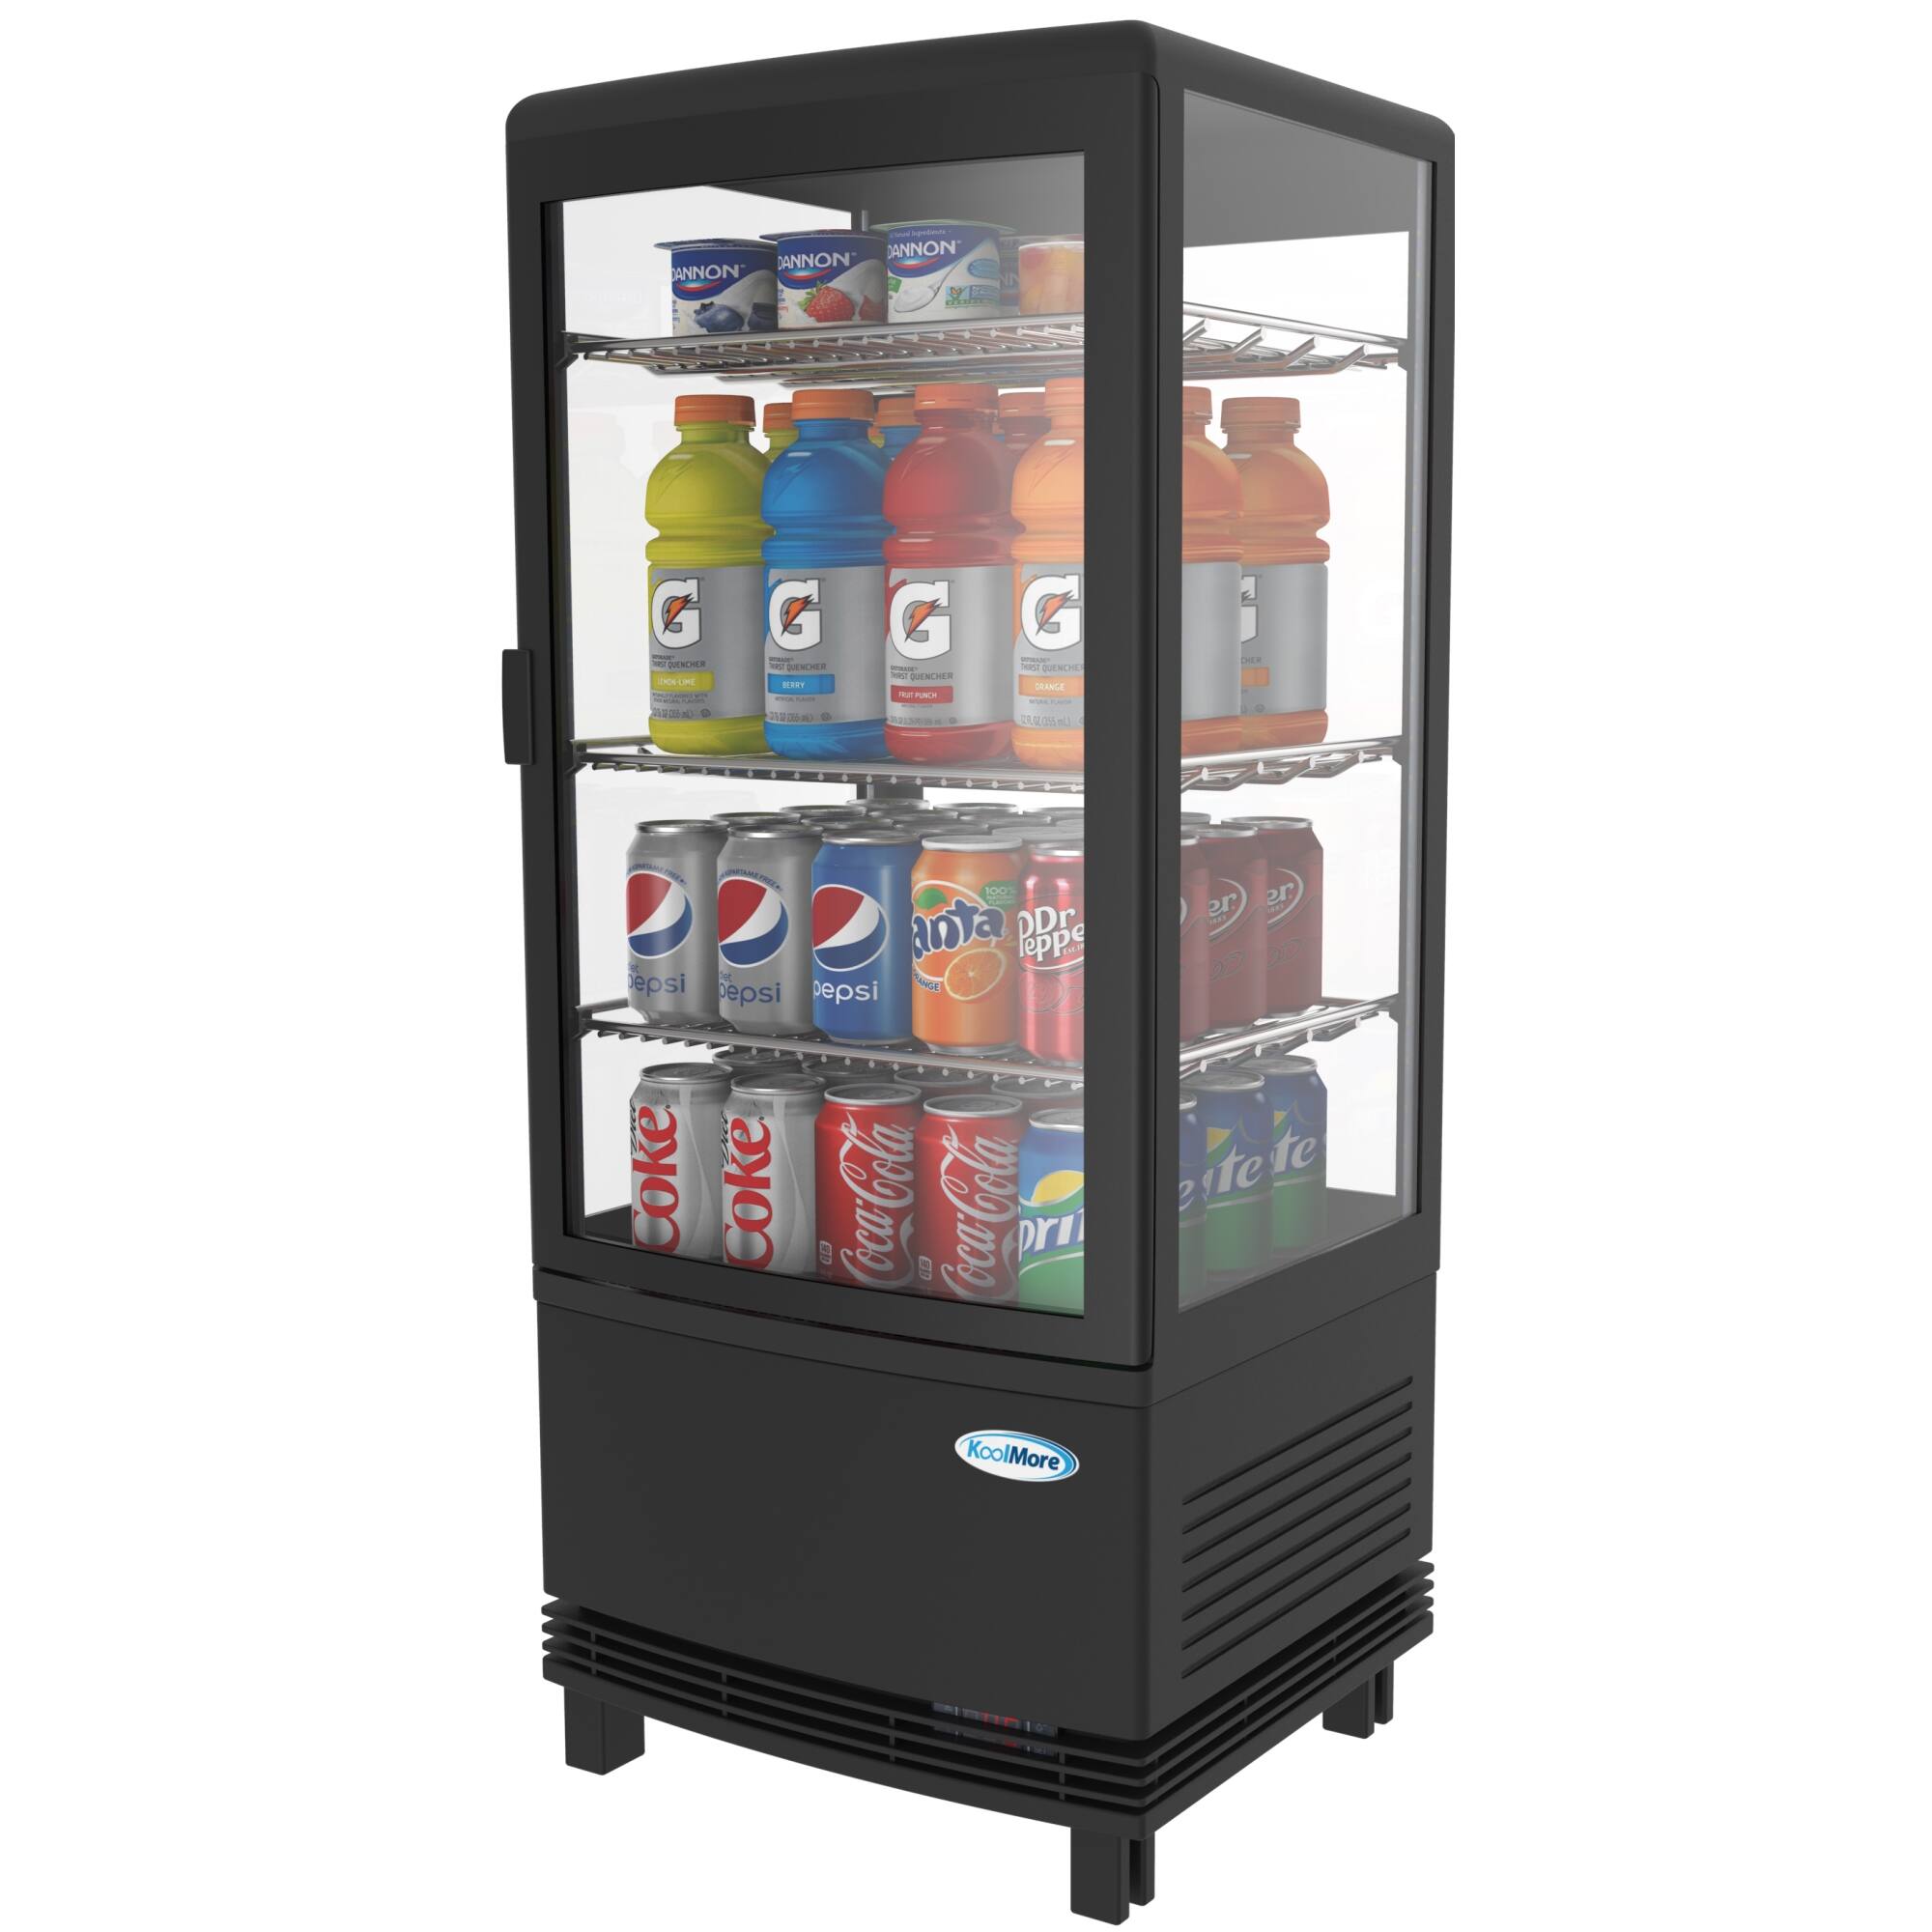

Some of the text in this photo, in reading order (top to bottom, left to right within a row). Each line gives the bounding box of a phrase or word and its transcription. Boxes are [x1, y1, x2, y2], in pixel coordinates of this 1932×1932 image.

[778, 252, 850, 271] DANNON
[668, 660, 706, 669] QUENCHER
[786, 663, 828, 672] QUENCHER
[781, 680, 805, 689] BERRY
[910, 671, 953, 682] QUENCHER
[1035, 682, 1065, 692] ORANGE
[913, 896, 1006, 961] anta
[1035, 906, 1076, 935] Dr
[1017, 910, 1084, 961] Peppe
[813, 980, 878, 1005] pepsi
[914, 973, 940, 992] RANGE
[633, 1105, 680, 1254] Coke
[724, 1117, 774, 1269] Coke
[967, 1438, 1061, 1470] KoolMore
